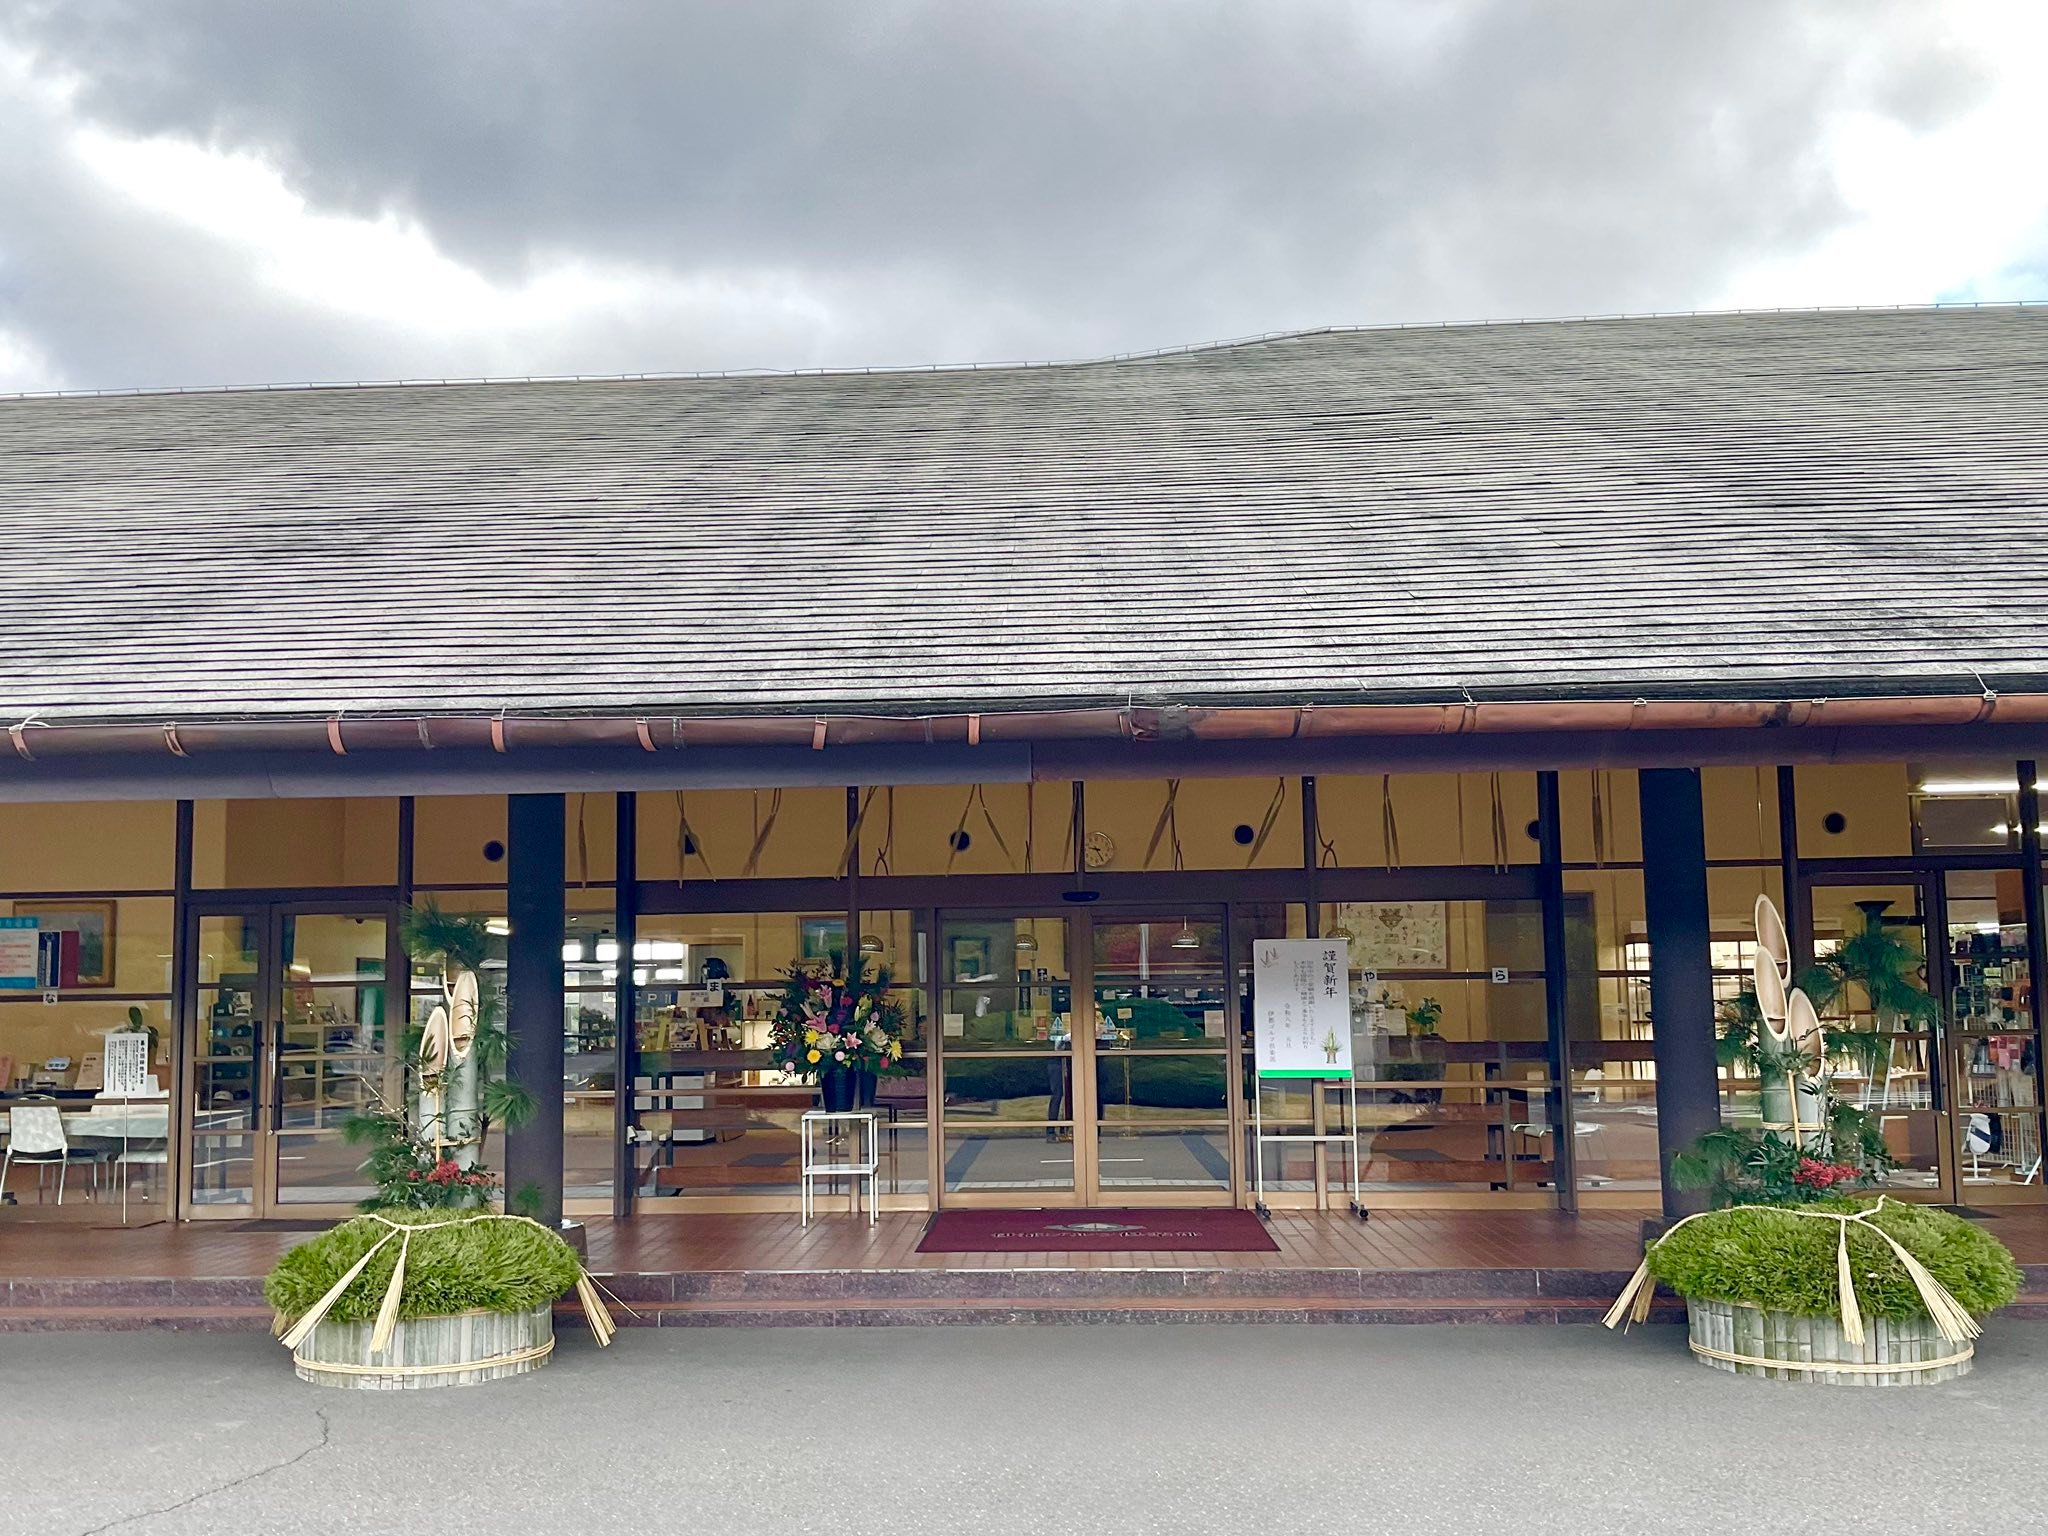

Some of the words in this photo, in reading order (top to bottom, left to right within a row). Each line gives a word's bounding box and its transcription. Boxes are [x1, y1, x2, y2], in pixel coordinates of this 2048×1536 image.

[1322, 950, 1339, 999] 謹賀新年
[1363, 970, 1375, 982] や
[1495, 970, 1506, 981] ら
[709, 981, 720, 992] ま
